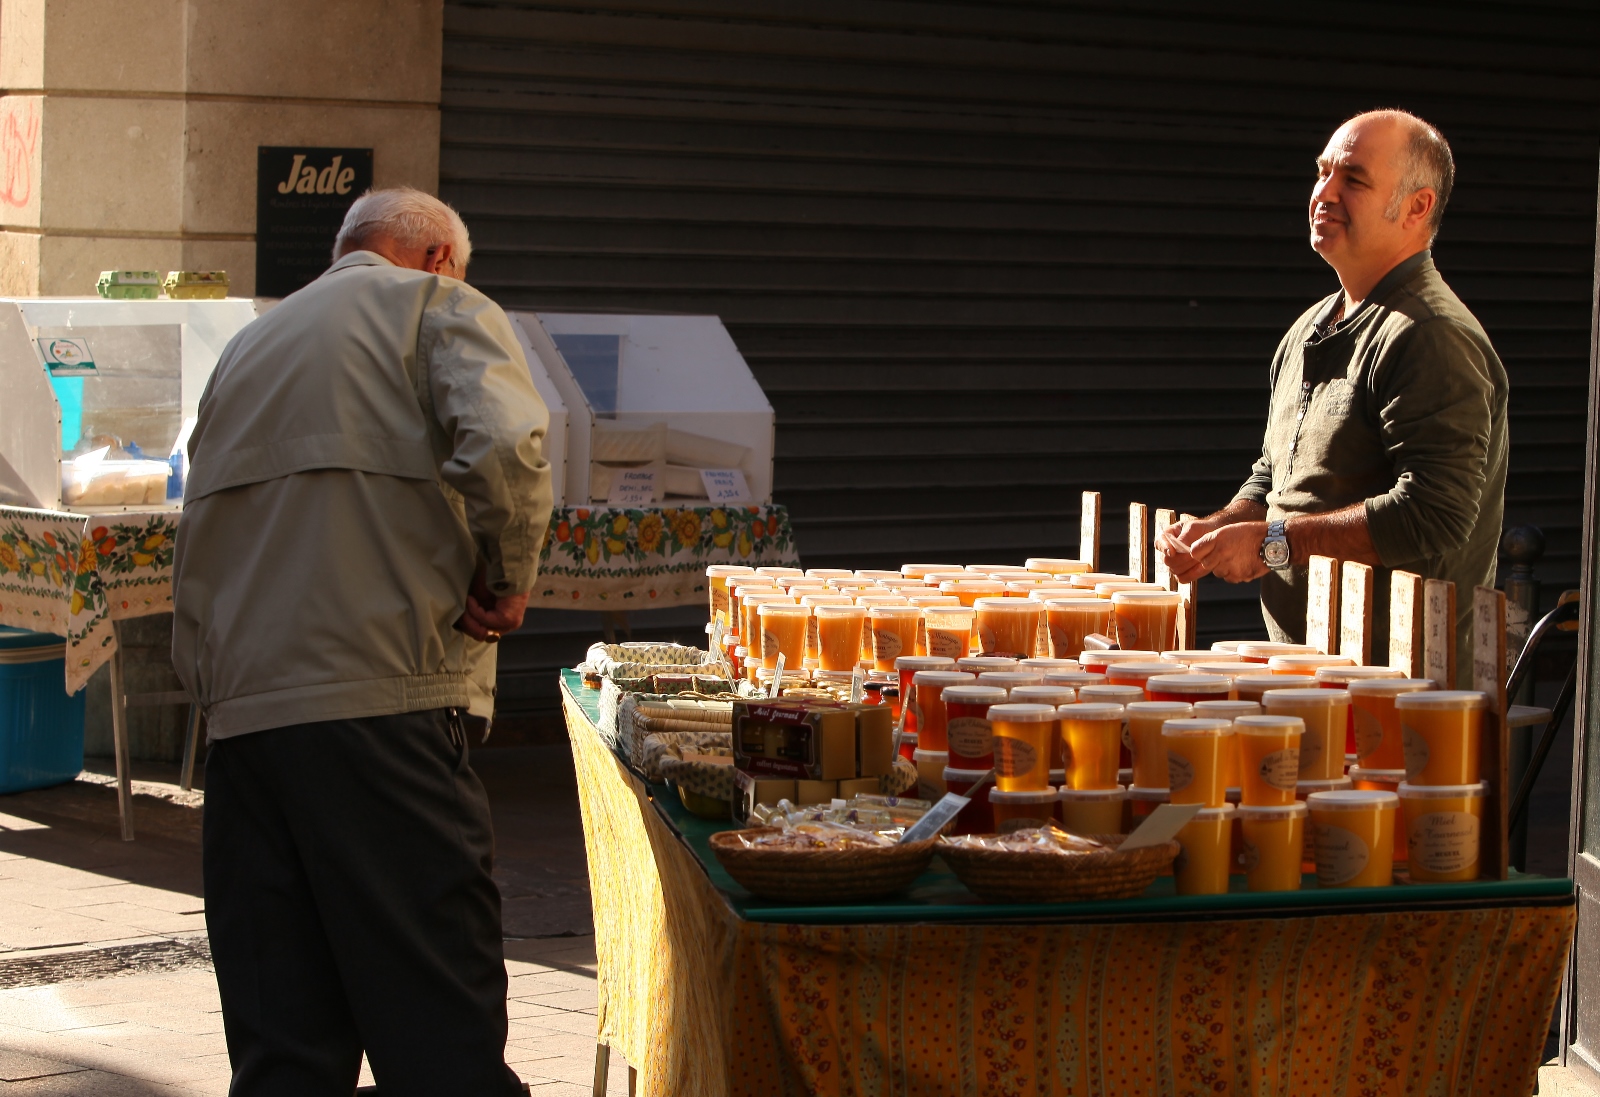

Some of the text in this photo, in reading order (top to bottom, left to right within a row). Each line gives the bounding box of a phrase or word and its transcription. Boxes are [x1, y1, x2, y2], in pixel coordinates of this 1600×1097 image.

[277, 154, 355, 195] Jade
[624, 472, 654, 480] FROMAGE
[769, 709, 799, 722] Gourmand
[1429, 814, 1456, 826] Miel
[1425, 825, 1473, 838] Tournesol
